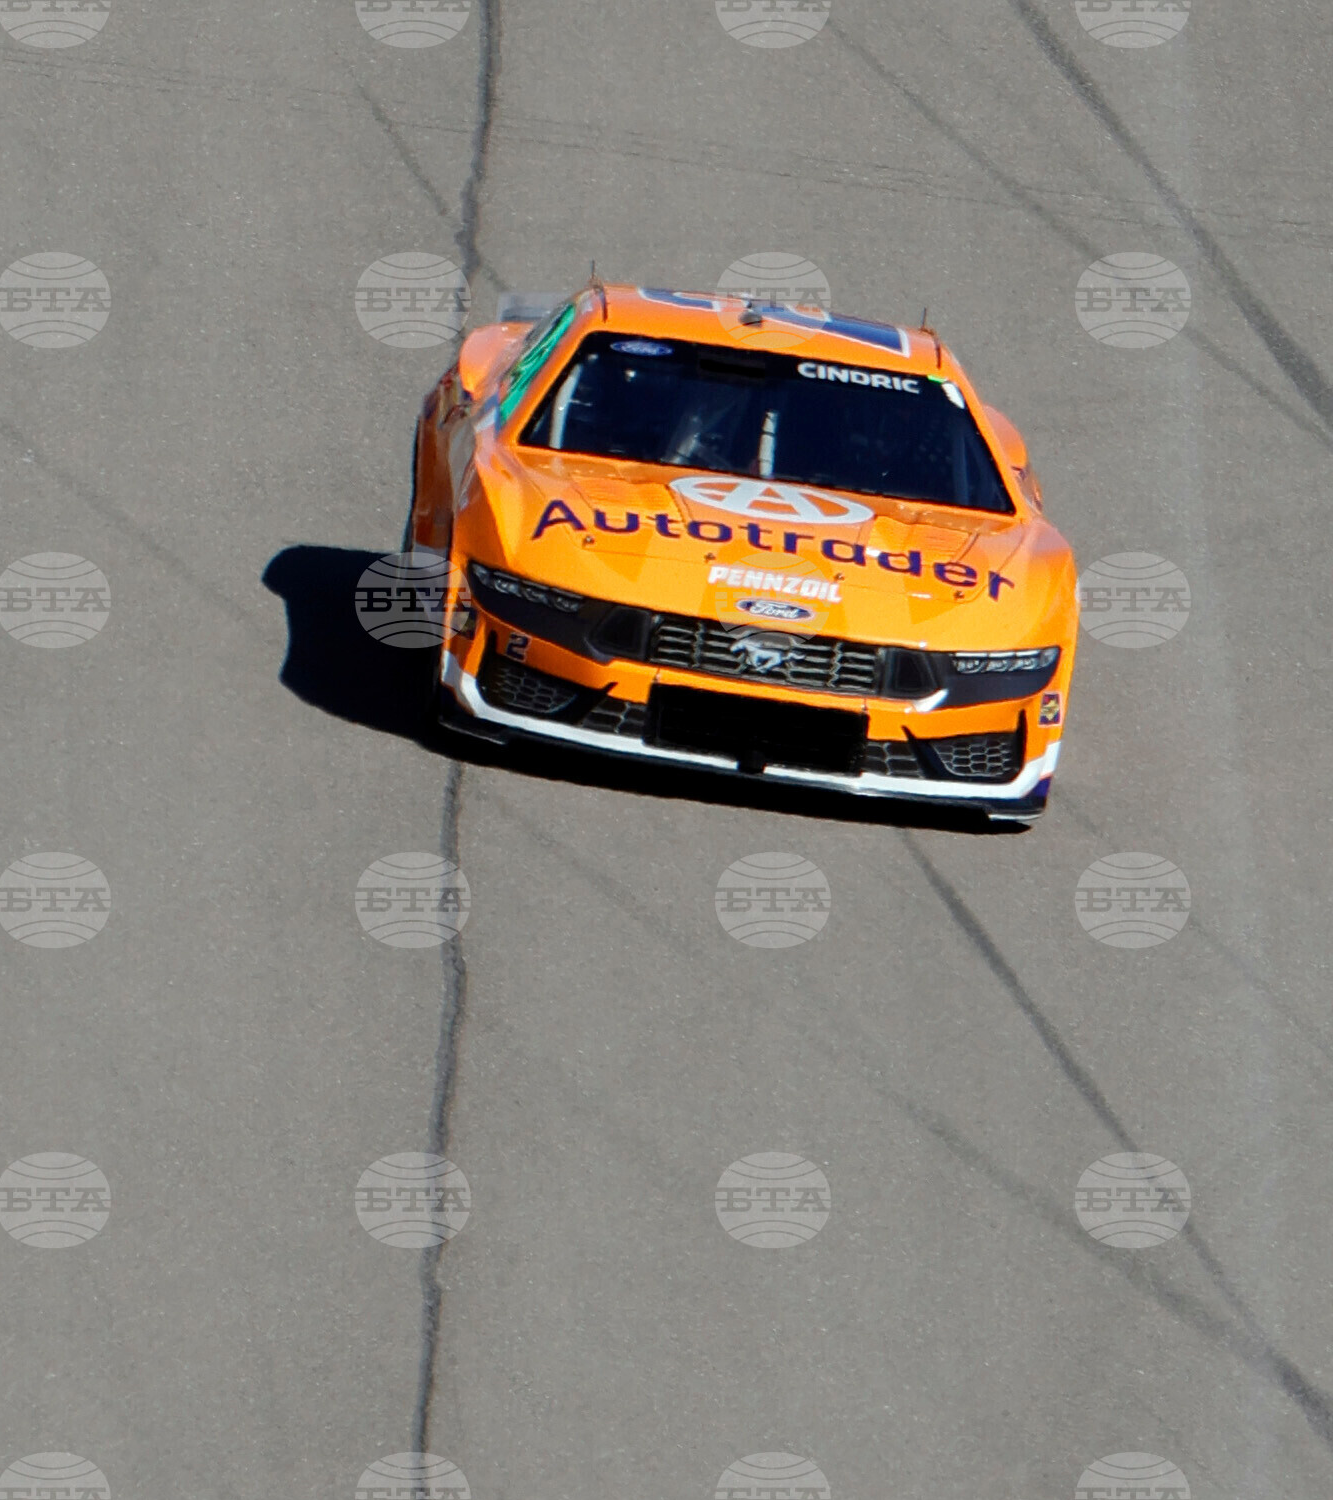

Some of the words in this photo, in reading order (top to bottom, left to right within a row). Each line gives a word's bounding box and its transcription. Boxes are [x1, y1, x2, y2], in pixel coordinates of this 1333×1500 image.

[797, 360, 920, 395] CINDRIC
[532, 499, 1015, 602] Autotrader
[708, 565, 843, 603] PENNZOIL
[744, 600, 807, 621] Ford
[505, 631, 532, 662] 2
